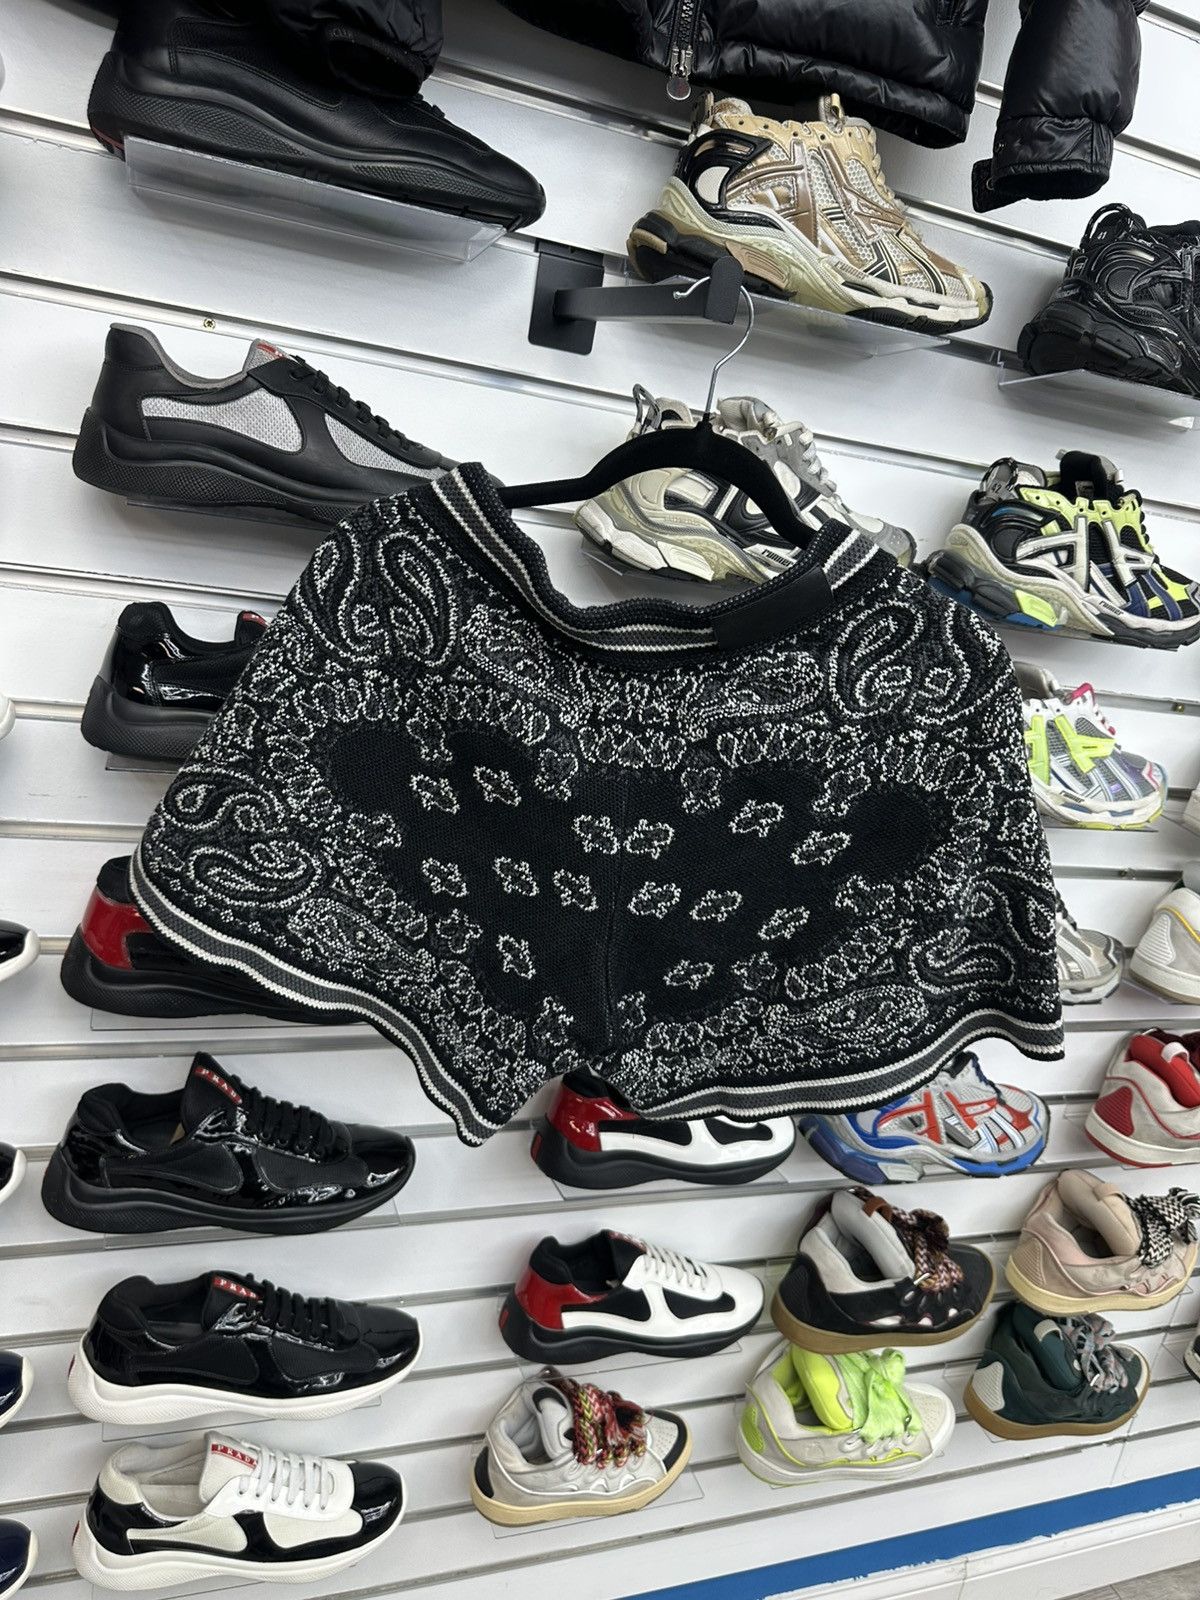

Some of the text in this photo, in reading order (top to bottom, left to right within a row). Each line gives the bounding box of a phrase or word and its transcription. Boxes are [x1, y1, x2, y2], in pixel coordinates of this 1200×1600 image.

[761, 548, 794, 567] runner
[220, 1278, 258, 1299] PRAD
[217, 1444, 258, 1466] PRADA
